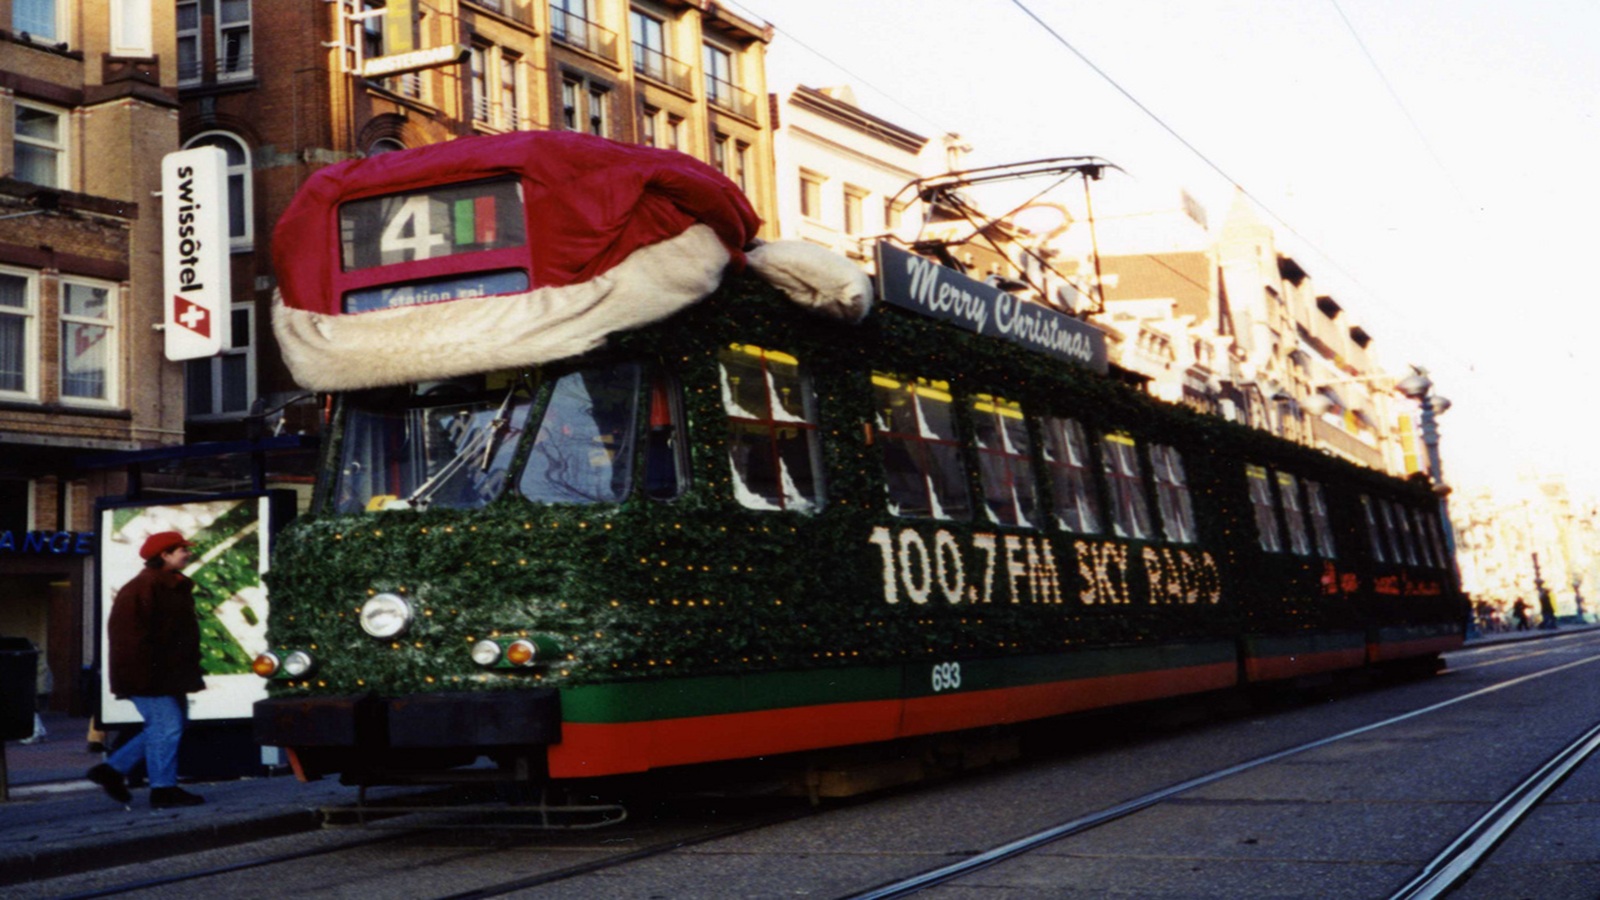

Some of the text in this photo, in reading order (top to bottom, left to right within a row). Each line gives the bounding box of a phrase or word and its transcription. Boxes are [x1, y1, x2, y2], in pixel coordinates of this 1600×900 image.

[177, 166, 204, 292] swissôtel
[381, 195, 444, 260] 4
[907, 255, 1093, 362] Merry Christmas
[1074, 539, 1131, 605] SKY
[932, 661, 961, 692] 693
